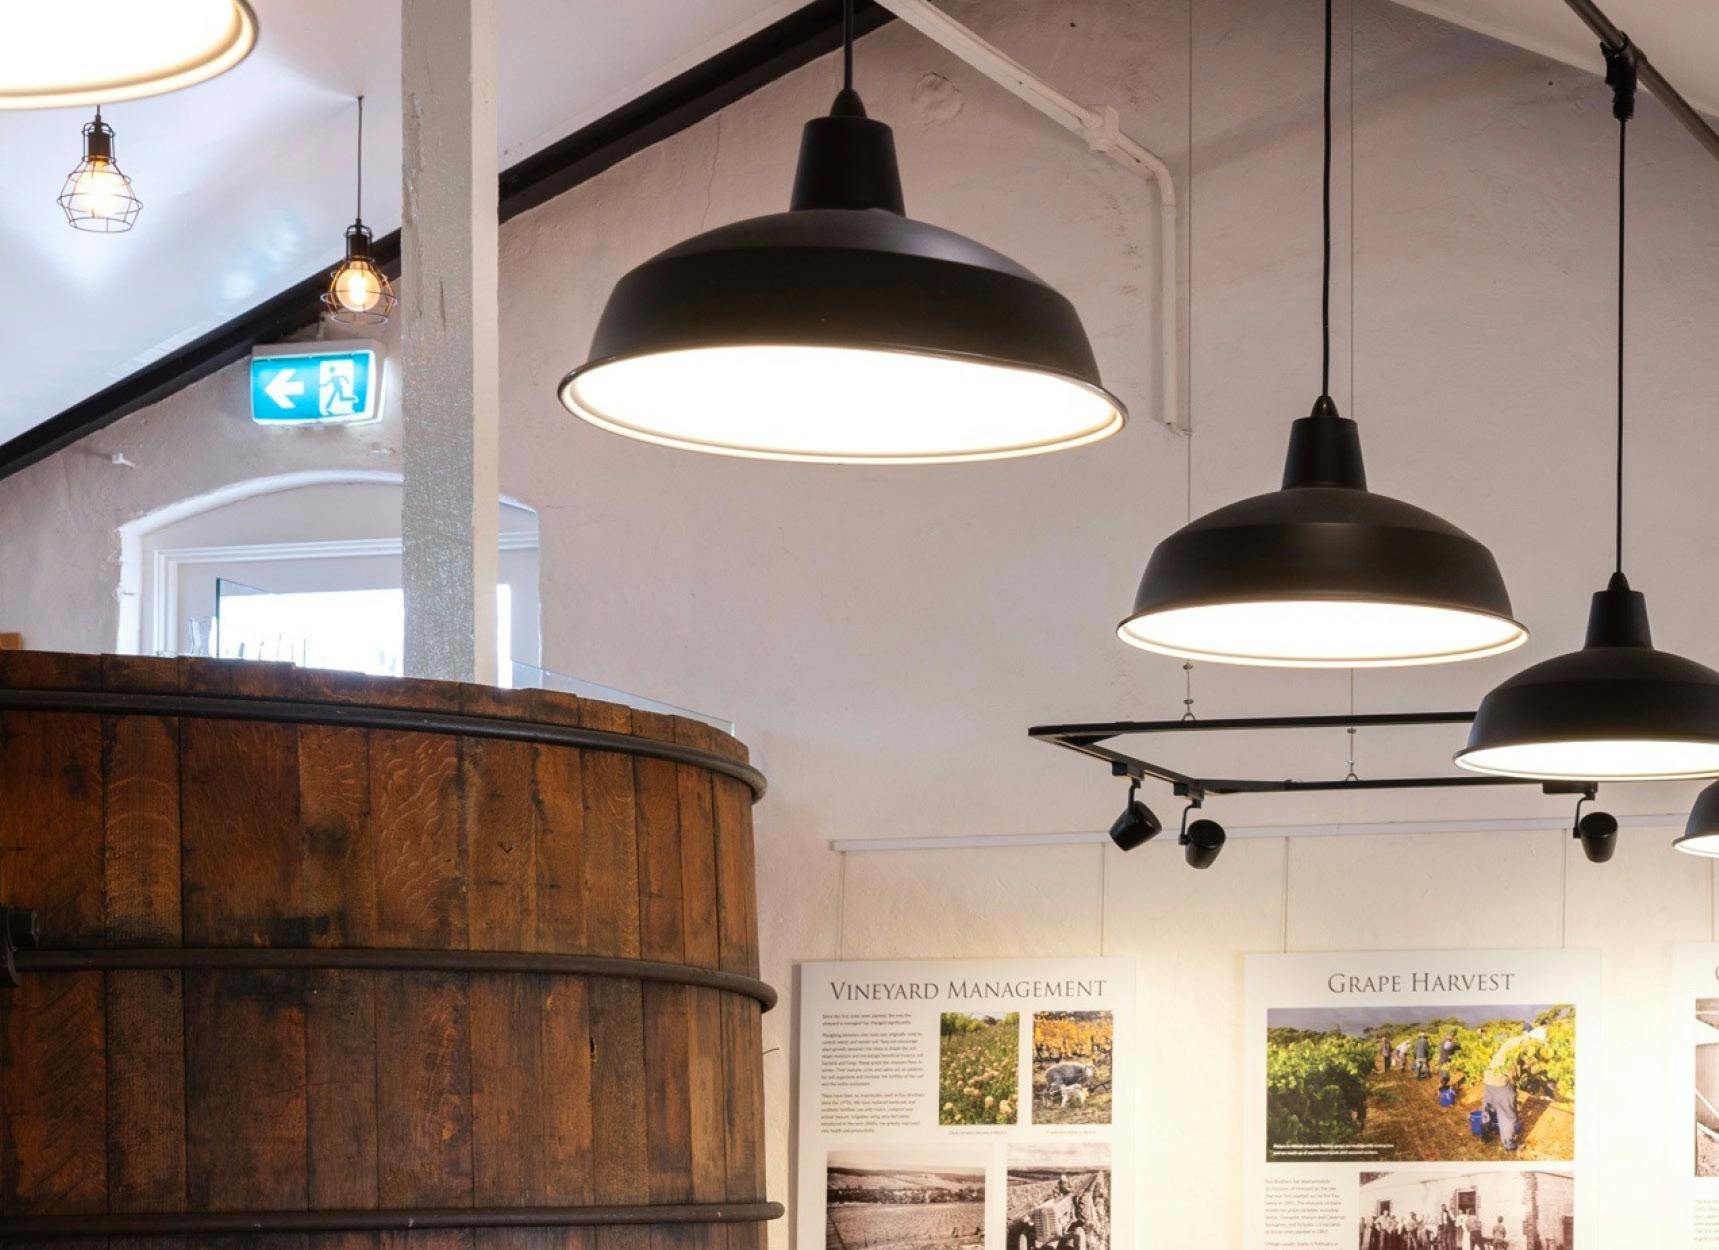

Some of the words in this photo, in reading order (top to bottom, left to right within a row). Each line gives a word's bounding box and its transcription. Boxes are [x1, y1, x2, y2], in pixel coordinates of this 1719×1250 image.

[830, 981, 939, 1001] VINEYARD
[948, 979, 1107, 999] MANAGEMENT
[1328, 973, 1401, 994] GRAPE
[1412, 972, 1515, 992] HARVEST
